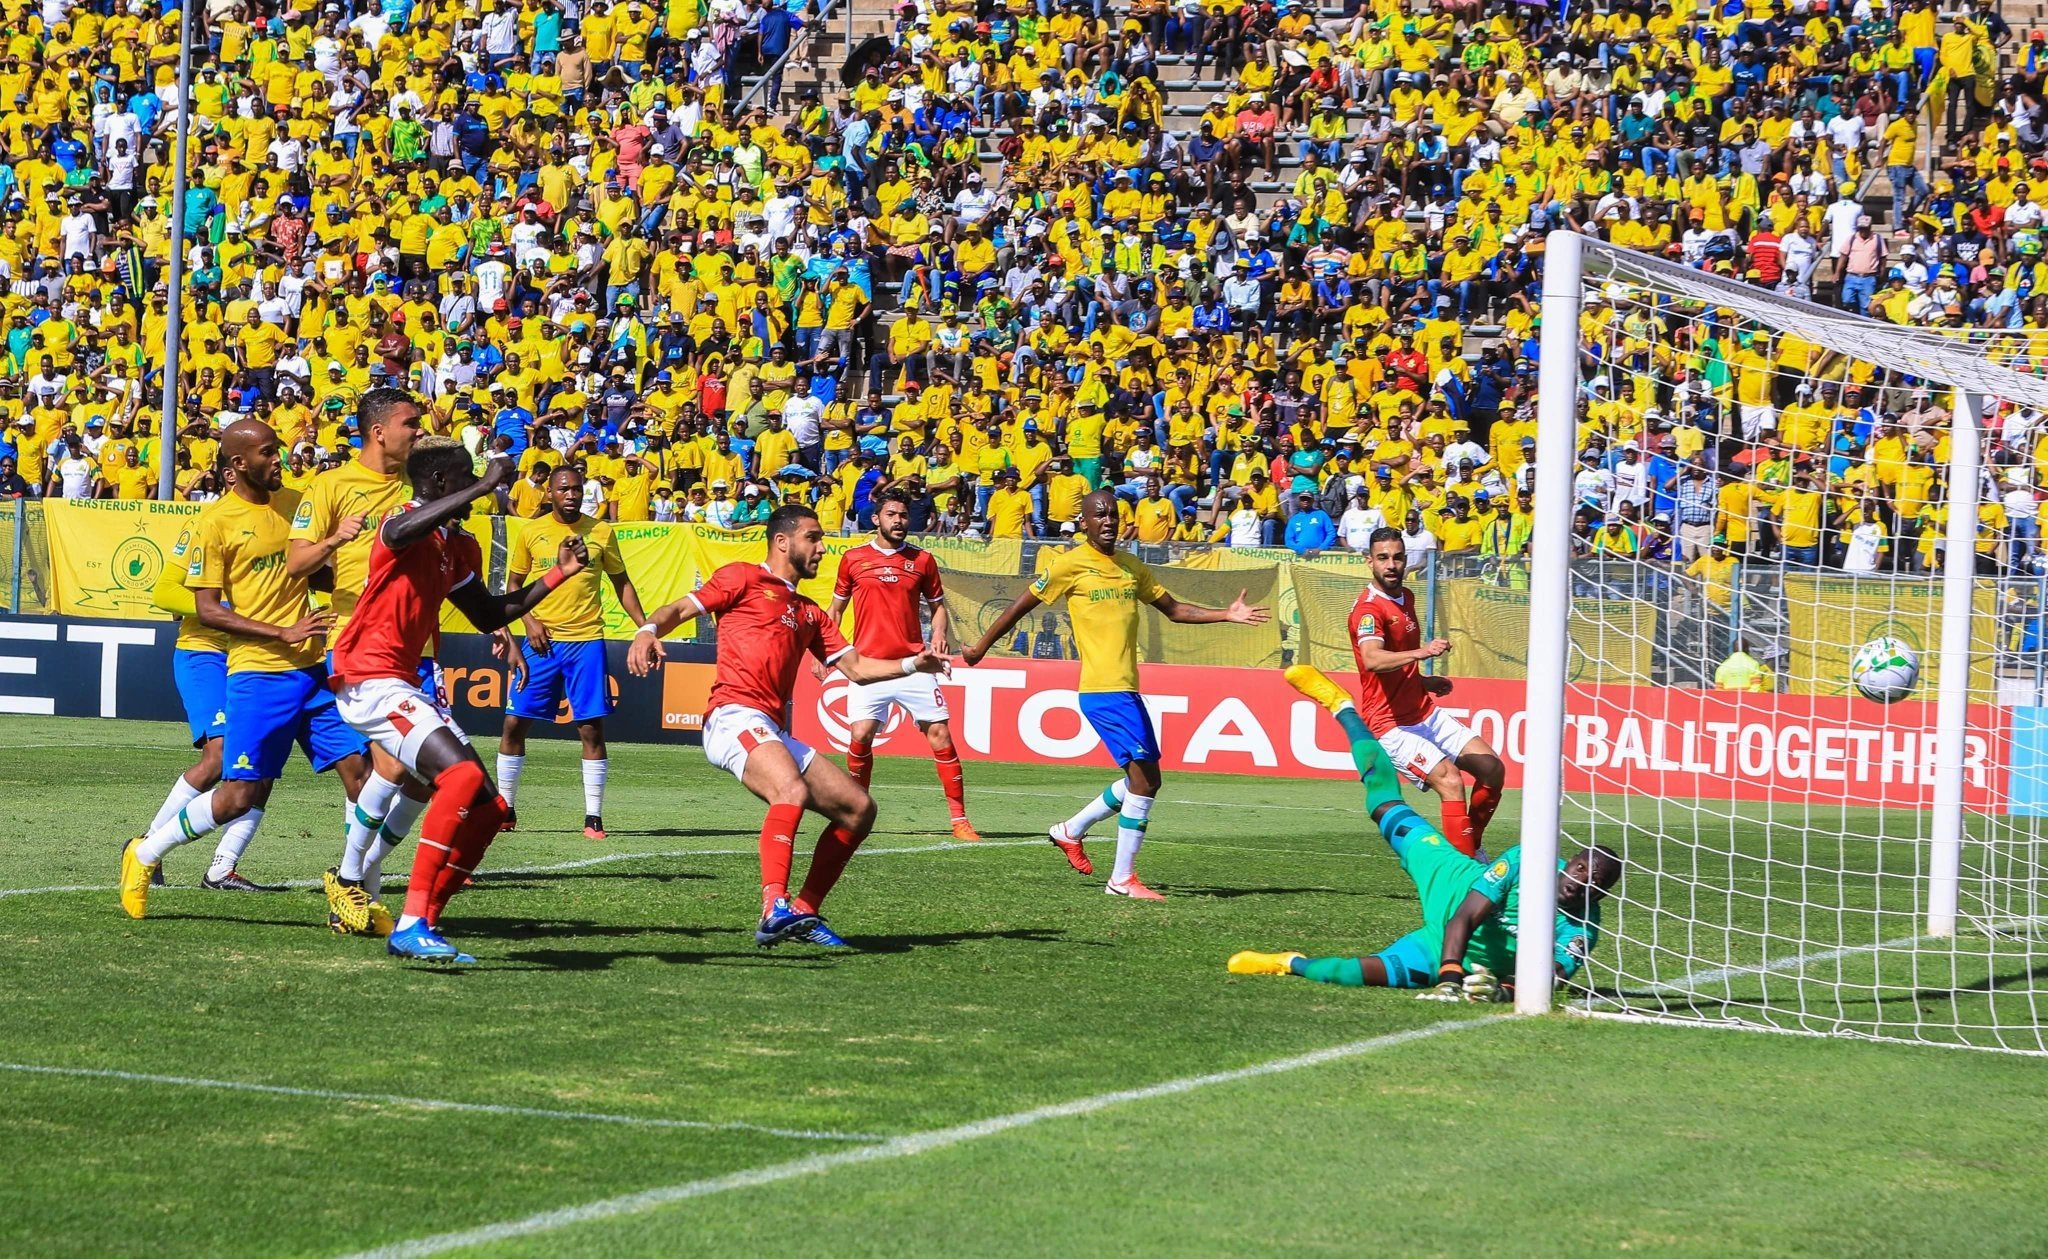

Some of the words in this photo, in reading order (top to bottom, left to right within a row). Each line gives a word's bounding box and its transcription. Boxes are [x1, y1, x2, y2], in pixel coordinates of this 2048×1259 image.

[69, 498, 143, 512] EERSTERUST
[149, 503, 201, 515] BRANCH
[617, 526, 669, 541] BRANCH
[880, 575, 898, 583] saib
[934, 688, 944, 707] 6
[665, 712, 703, 728] oran
